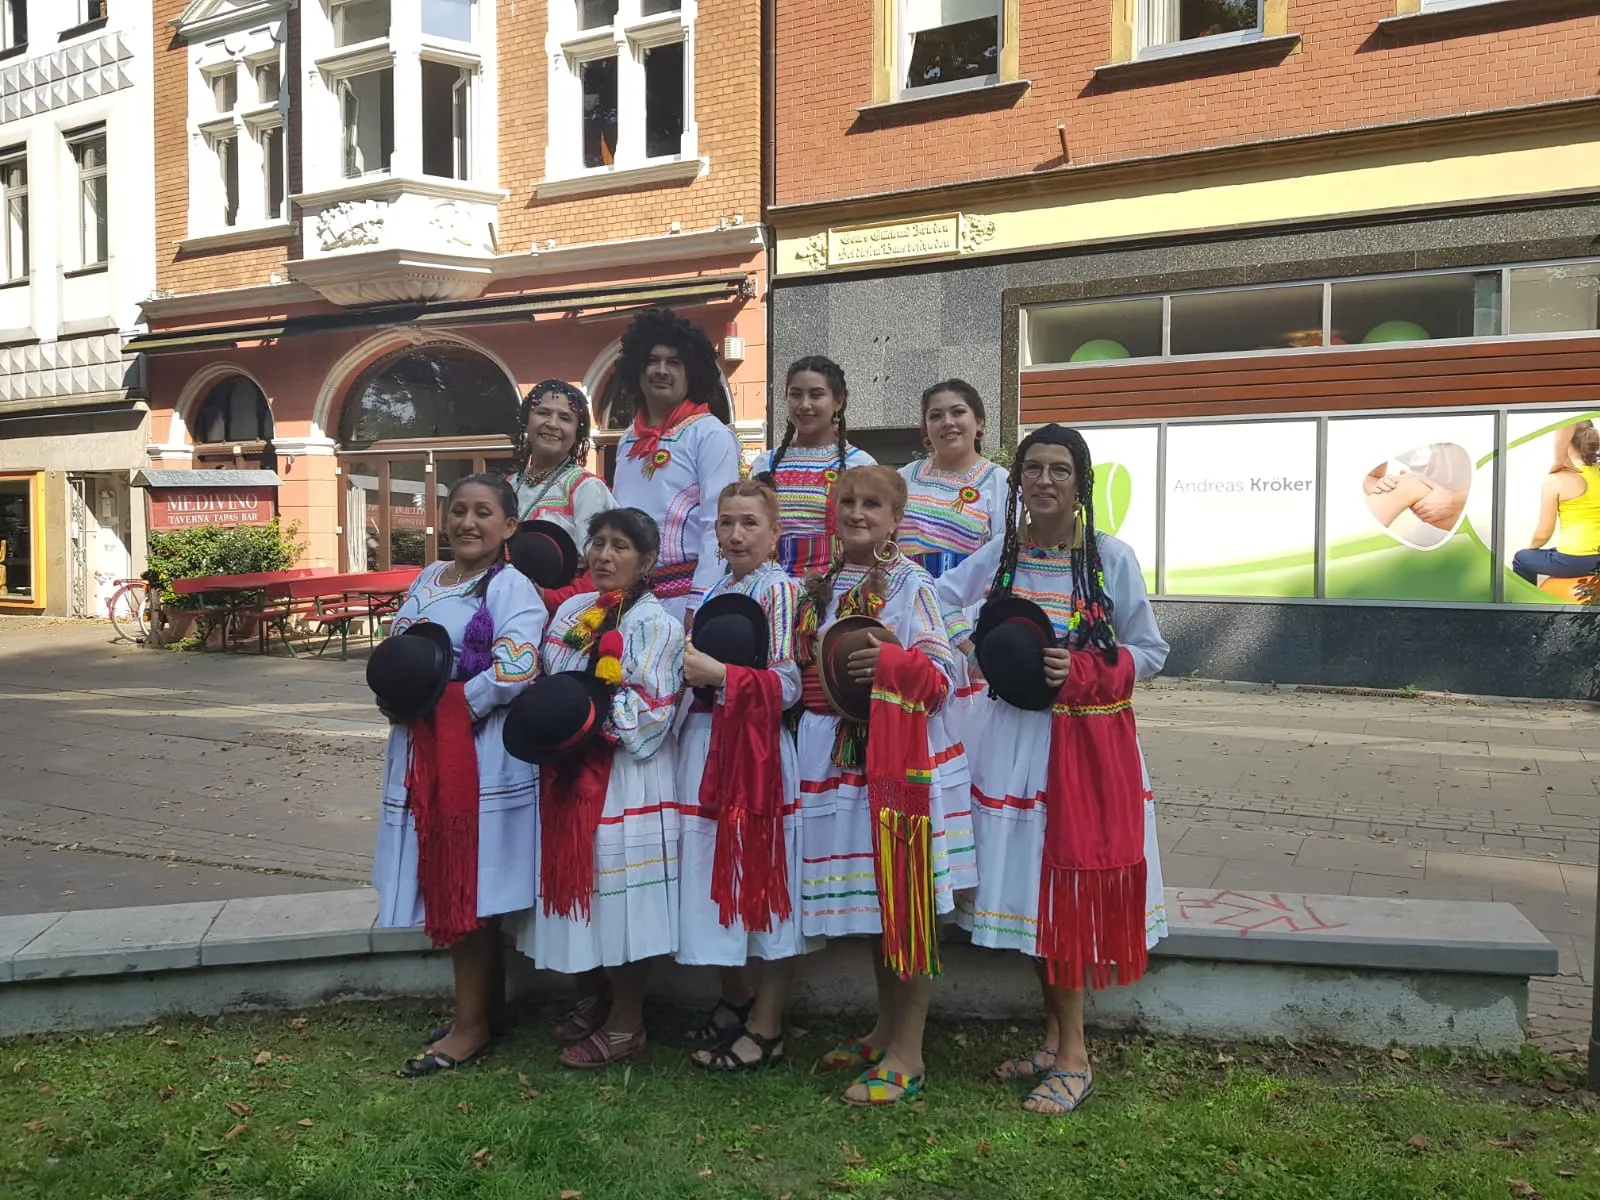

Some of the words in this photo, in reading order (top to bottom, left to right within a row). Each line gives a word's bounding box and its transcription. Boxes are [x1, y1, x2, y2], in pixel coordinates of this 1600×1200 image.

[1173, 478, 1244, 493] Andreas
[1250, 476, 1313, 492] Kröker
[167, 493, 258, 512] MEDIVINO
[168, 513, 210, 525] TAVERNA
[213, 511, 239, 523] TAPAS
[241, 511, 258, 521] BAR
